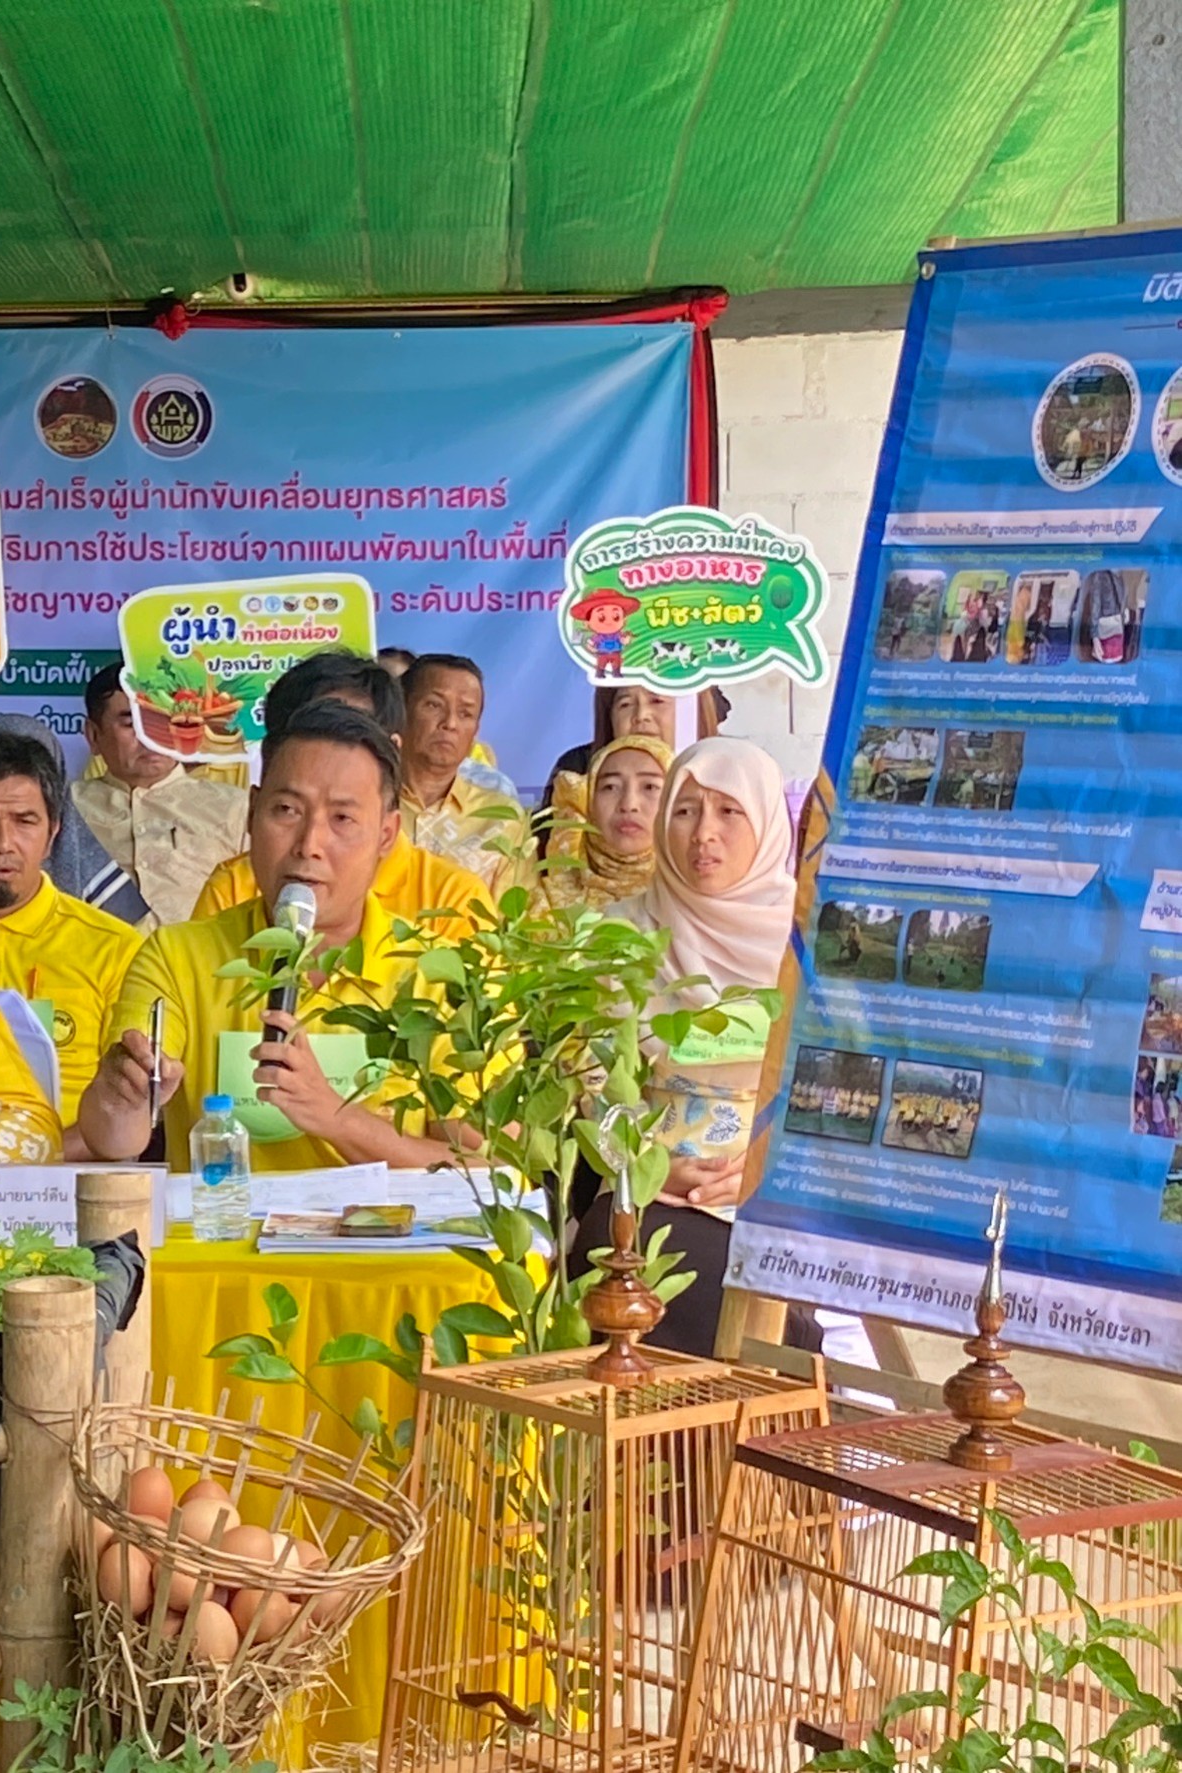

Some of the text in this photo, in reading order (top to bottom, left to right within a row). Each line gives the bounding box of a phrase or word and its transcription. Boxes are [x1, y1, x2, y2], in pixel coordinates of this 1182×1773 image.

[0, 471, 508, 520] มสำเร็จผู้นำนักขับเคลื่อนยุทธศาสตร์
[2, 520, 568, 562] ริมการใช้ประโยชน์จากแผนพัฒนาในพื้นที่
[581, 522, 804, 566] การสร้างความมั่นคง
[622, 558, 764, 586] ทางอาหาร
[162, 605, 339, 655] ผู้นำ ทำต่อเนื่อง
[645, 594, 763, 628] พืช+สัตว์
[207, 654, 273, 680] ปลูกพืช
